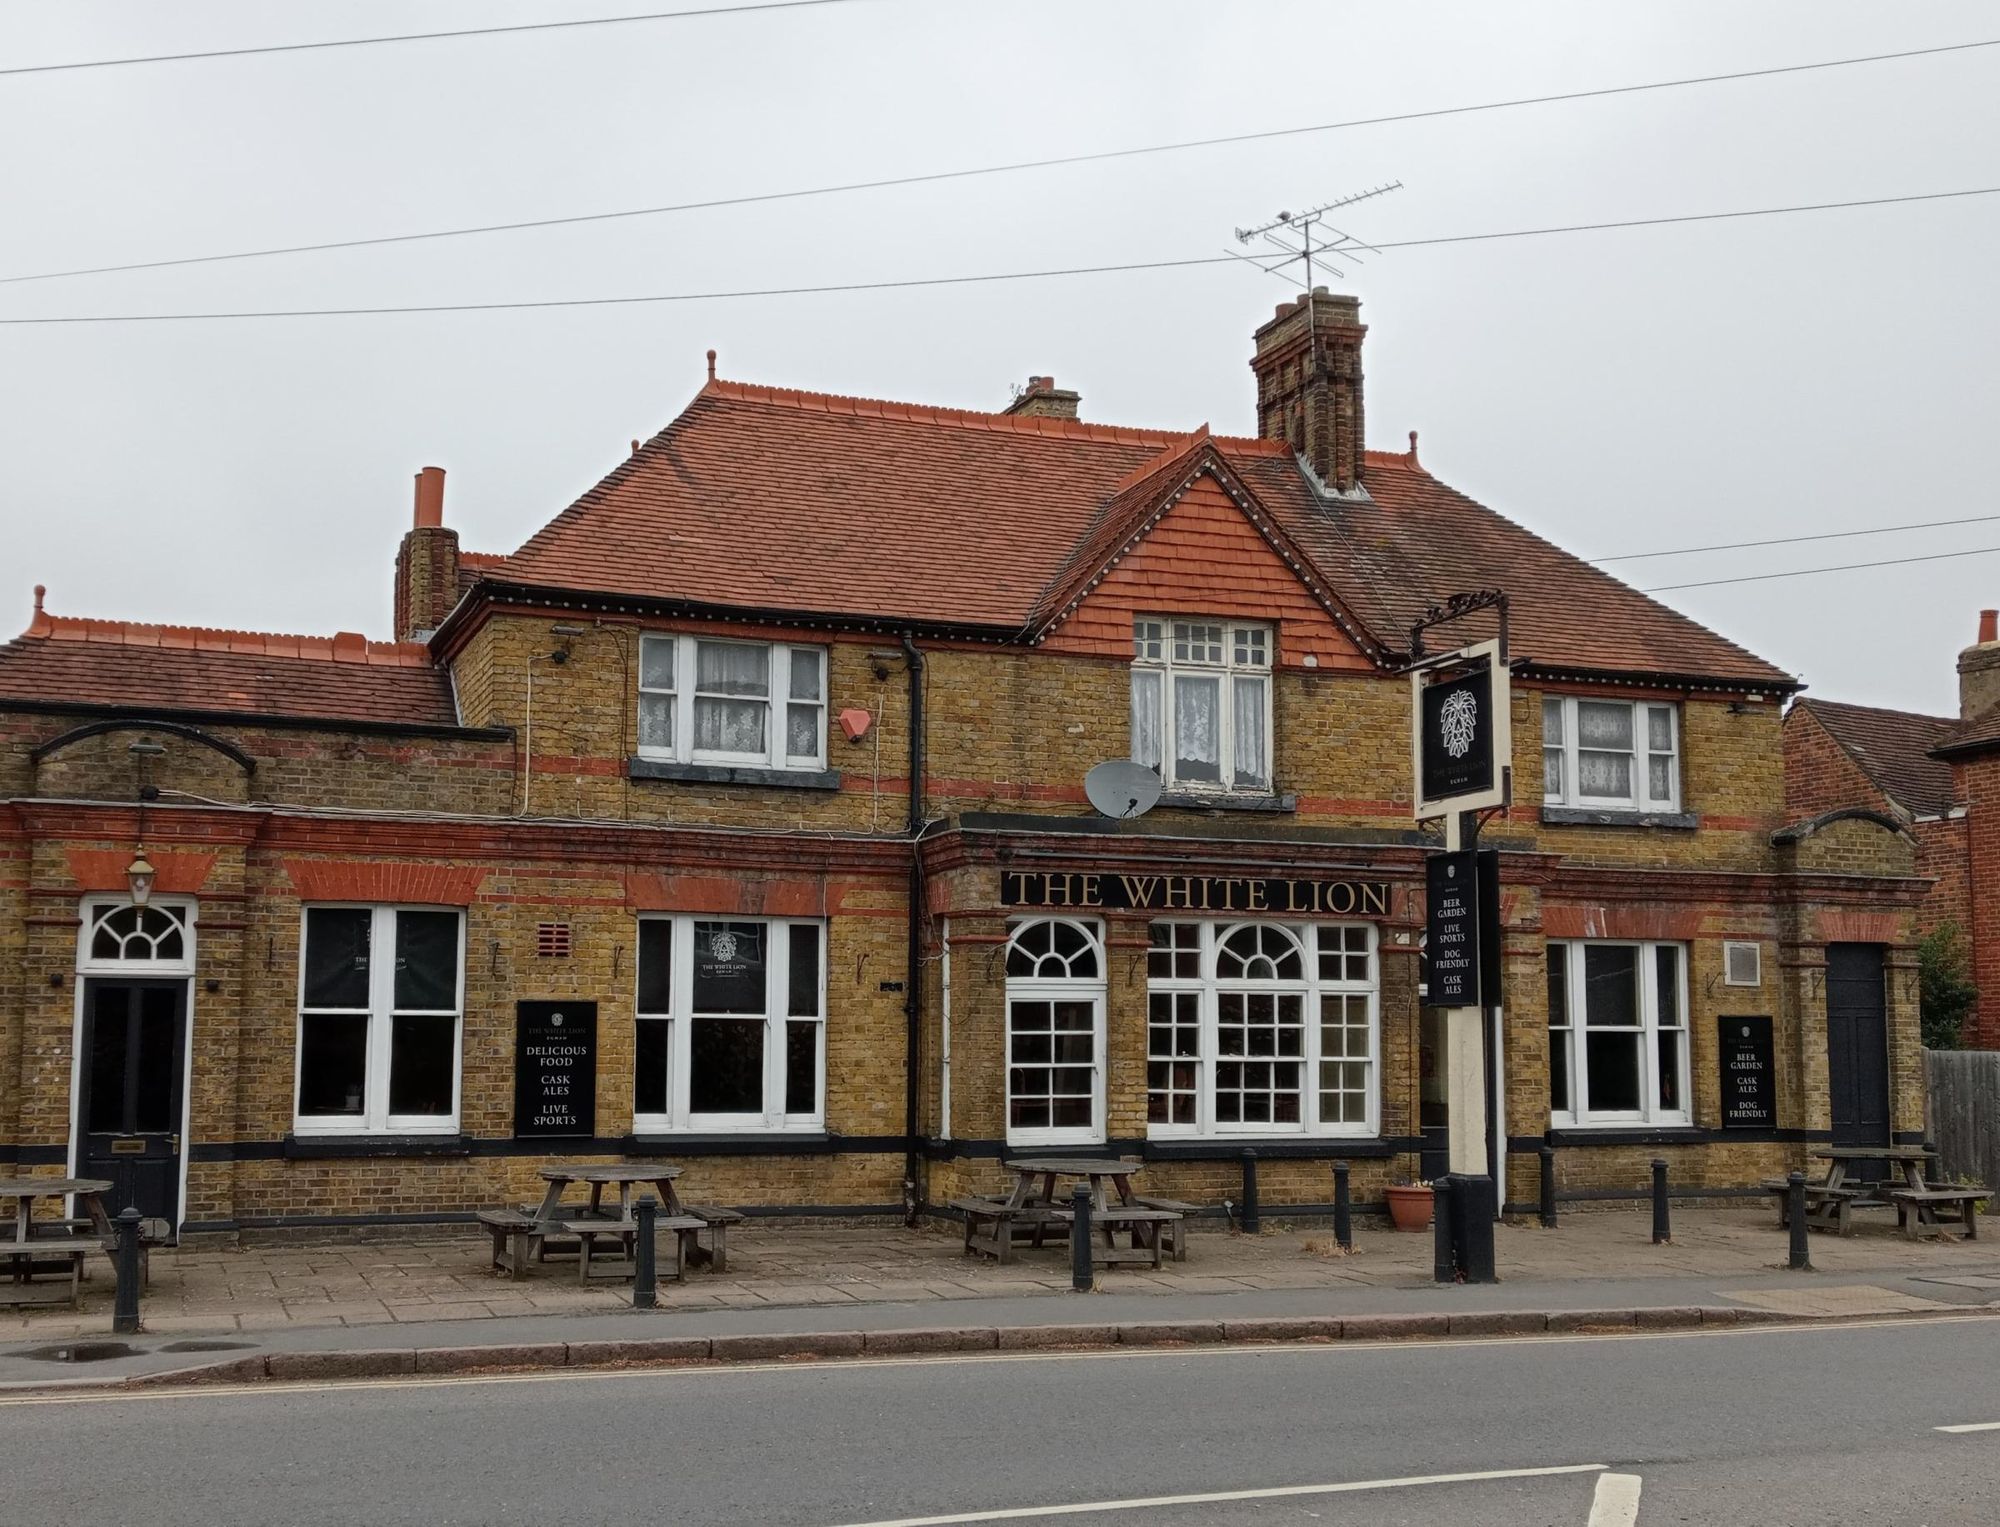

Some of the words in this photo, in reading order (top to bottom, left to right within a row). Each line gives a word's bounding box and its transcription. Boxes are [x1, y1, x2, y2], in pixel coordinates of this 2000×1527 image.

[1008, 871, 1103, 906] THE
[1118, 875, 1269, 911] WHITE
[1285, 880, 1389, 914] LION
[1443, 898, 1460, 908] BEER
[1437, 907, 1467, 918] GARDEN
[1444, 923, 1461, 933] LIVE
[1439, 933, 1465, 943] SPORTS
[1444, 949, 1461, 959] DOG
[1436, 958, 1470, 969] FRIENDLY
[1443, 975, 1462, 985] CASK
[1444, 985, 1462, 995] ALES
[526, 1046, 587, 1056] DELICIOUS
[540, 1057, 573, 1067] FOOD
[1736, 1053, 1756, 1061] BEER
[1730, 1061, 1763, 1070] GARDEN
[541, 1075, 571, 1085] CASK
[1736, 1076, 1758, 1085] CASK
[542, 1086, 570, 1096] ALES
[1738, 1085, 1758, 1093] ALES
[542, 1104, 569, 1114] LIVE
[1739, 1101, 1758, 1109] DOG
[1729, 1110, 1768, 1118] FRIENDLY
[533, 1115, 577, 1126] SPORTS
